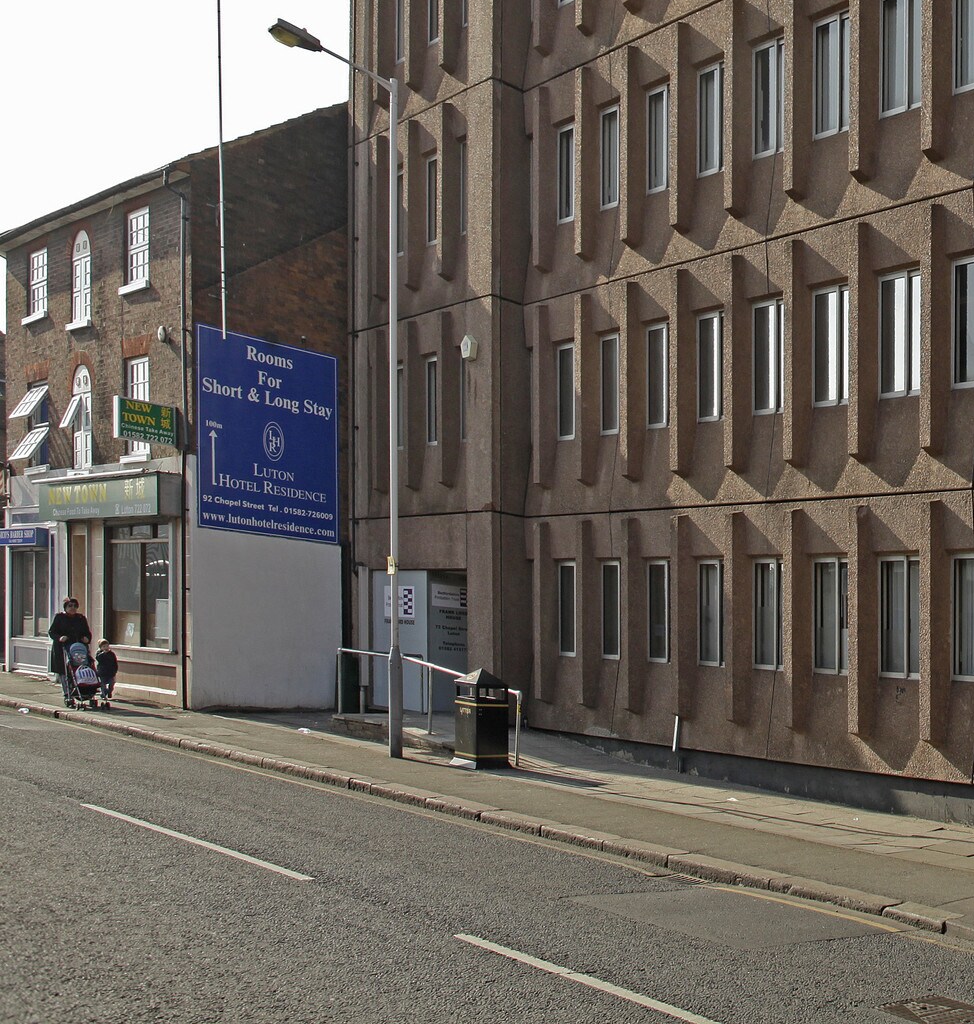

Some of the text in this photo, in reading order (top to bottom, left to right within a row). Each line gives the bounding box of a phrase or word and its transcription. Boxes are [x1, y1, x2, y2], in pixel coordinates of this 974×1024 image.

[246, 345, 293, 370] Rooms
[258, 370, 282, 390] For
[126, 400, 152, 413] NEW
[202, 378, 332, 420] Short & Long Stay
[121, 422, 144, 431] Chinese
[122, 412, 156, 426] TOWN
[206, 420, 222, 429] 100m
[123, 430, 144, 439] 01582
[160, 436, 173, 444] 072
[48, 484, 107, 505] NEW TOWN
[202, 494, 212, 504] 92
[214, 496, 241, 508] Chapel
[242, 500, 264, 511] Street
[284, 506, 333, 520] 01582-726009
[202, 510, 335, 538] www.lutonhotelresidence.com
